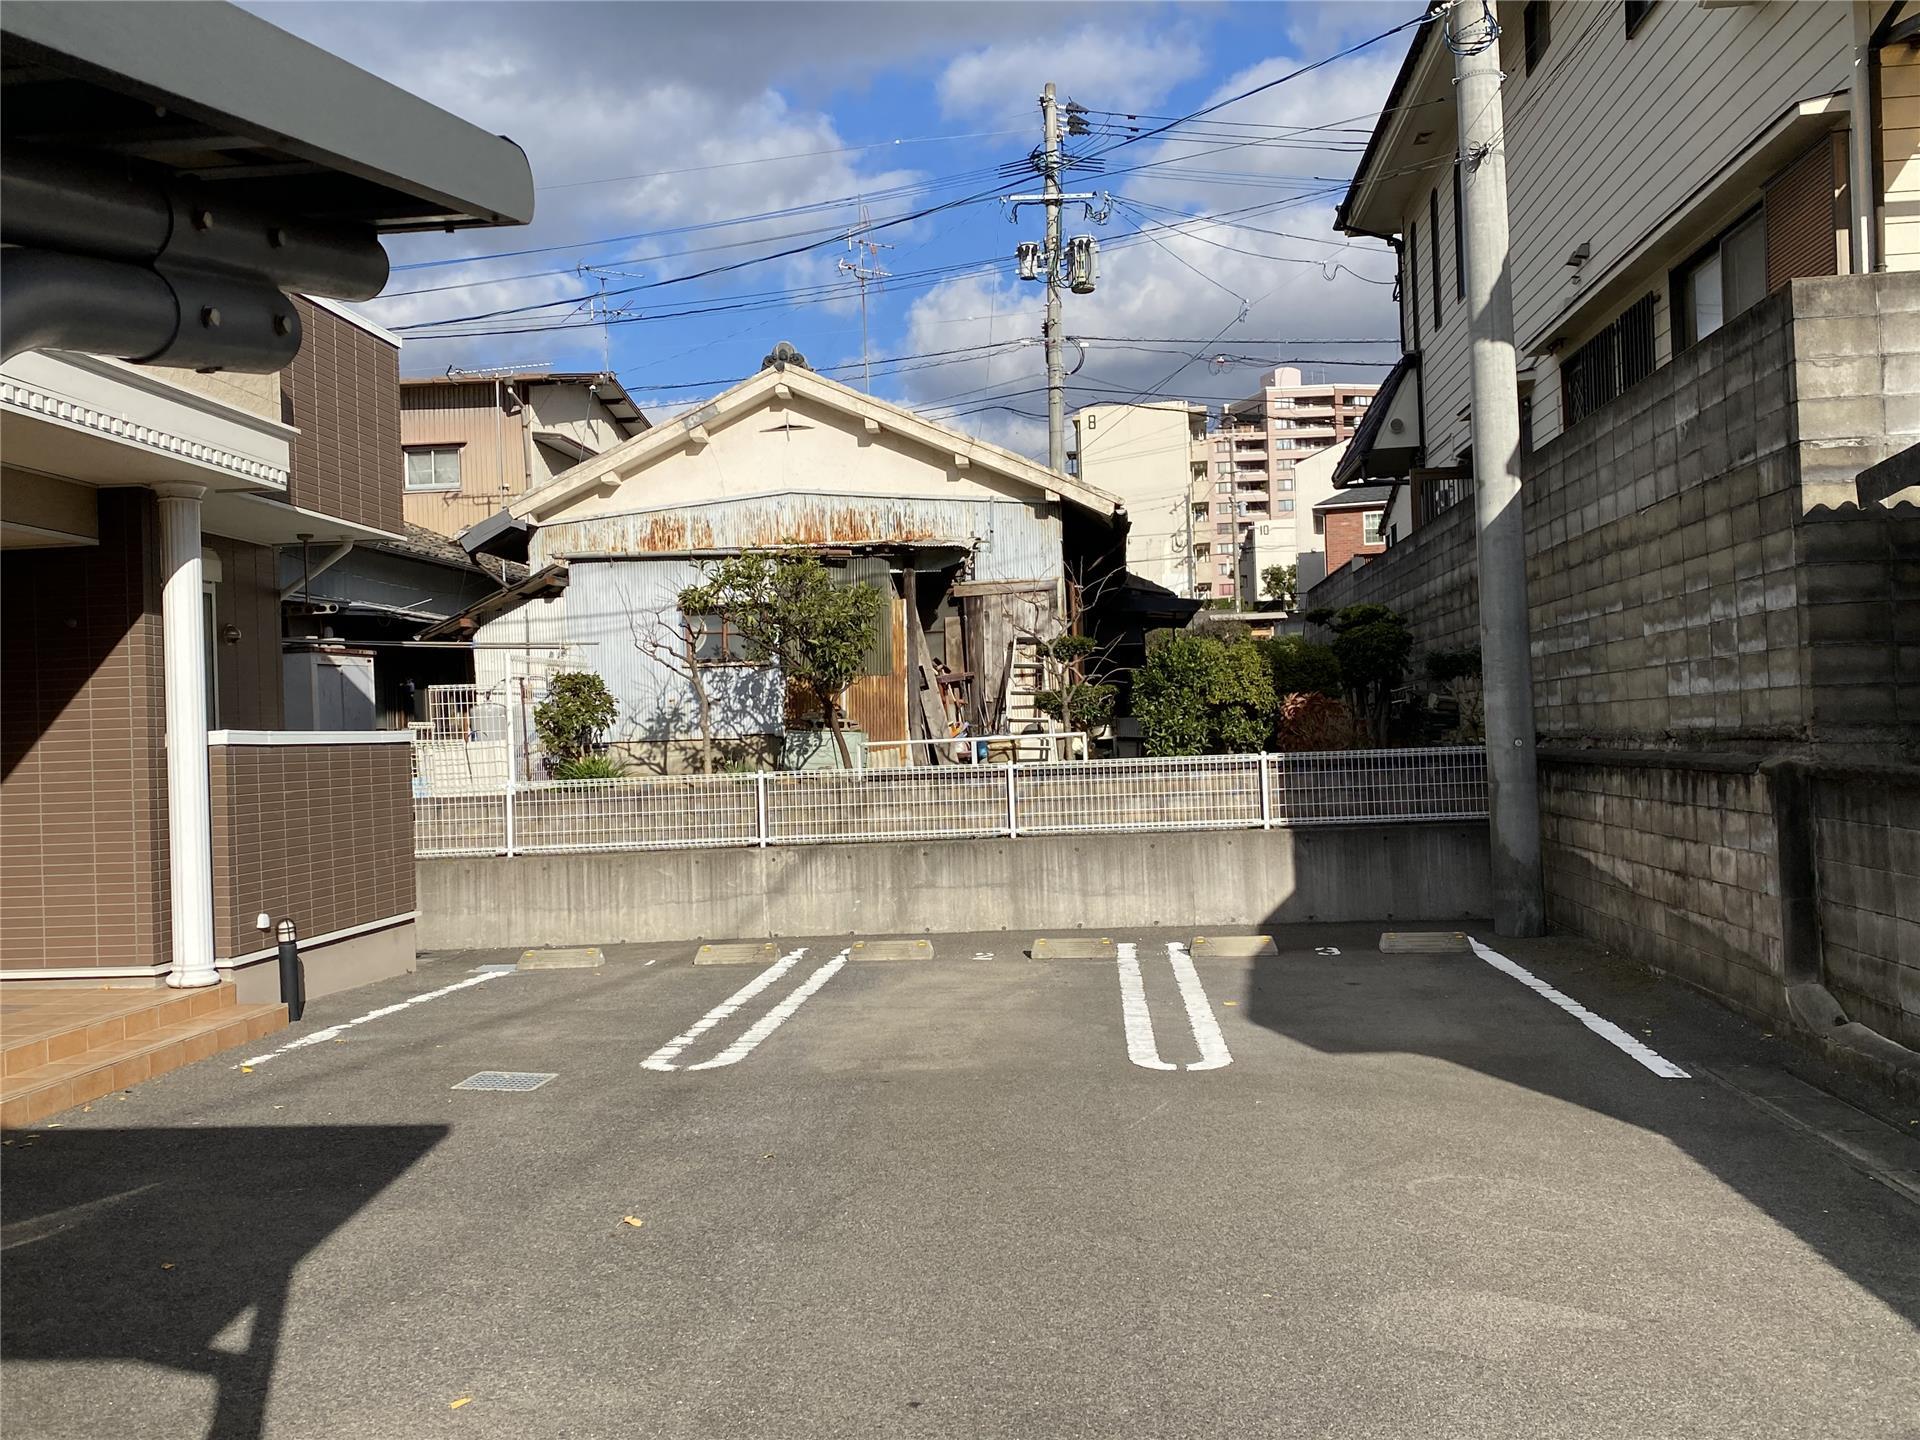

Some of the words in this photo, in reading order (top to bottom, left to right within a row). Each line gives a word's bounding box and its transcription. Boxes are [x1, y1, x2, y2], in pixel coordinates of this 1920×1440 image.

[1088, 415, 1096, 429] 8
[1259, 525, 1270, 536] 10
[972, 952, 995, 961] 2
[1314, 947, 1341, 956] 3
